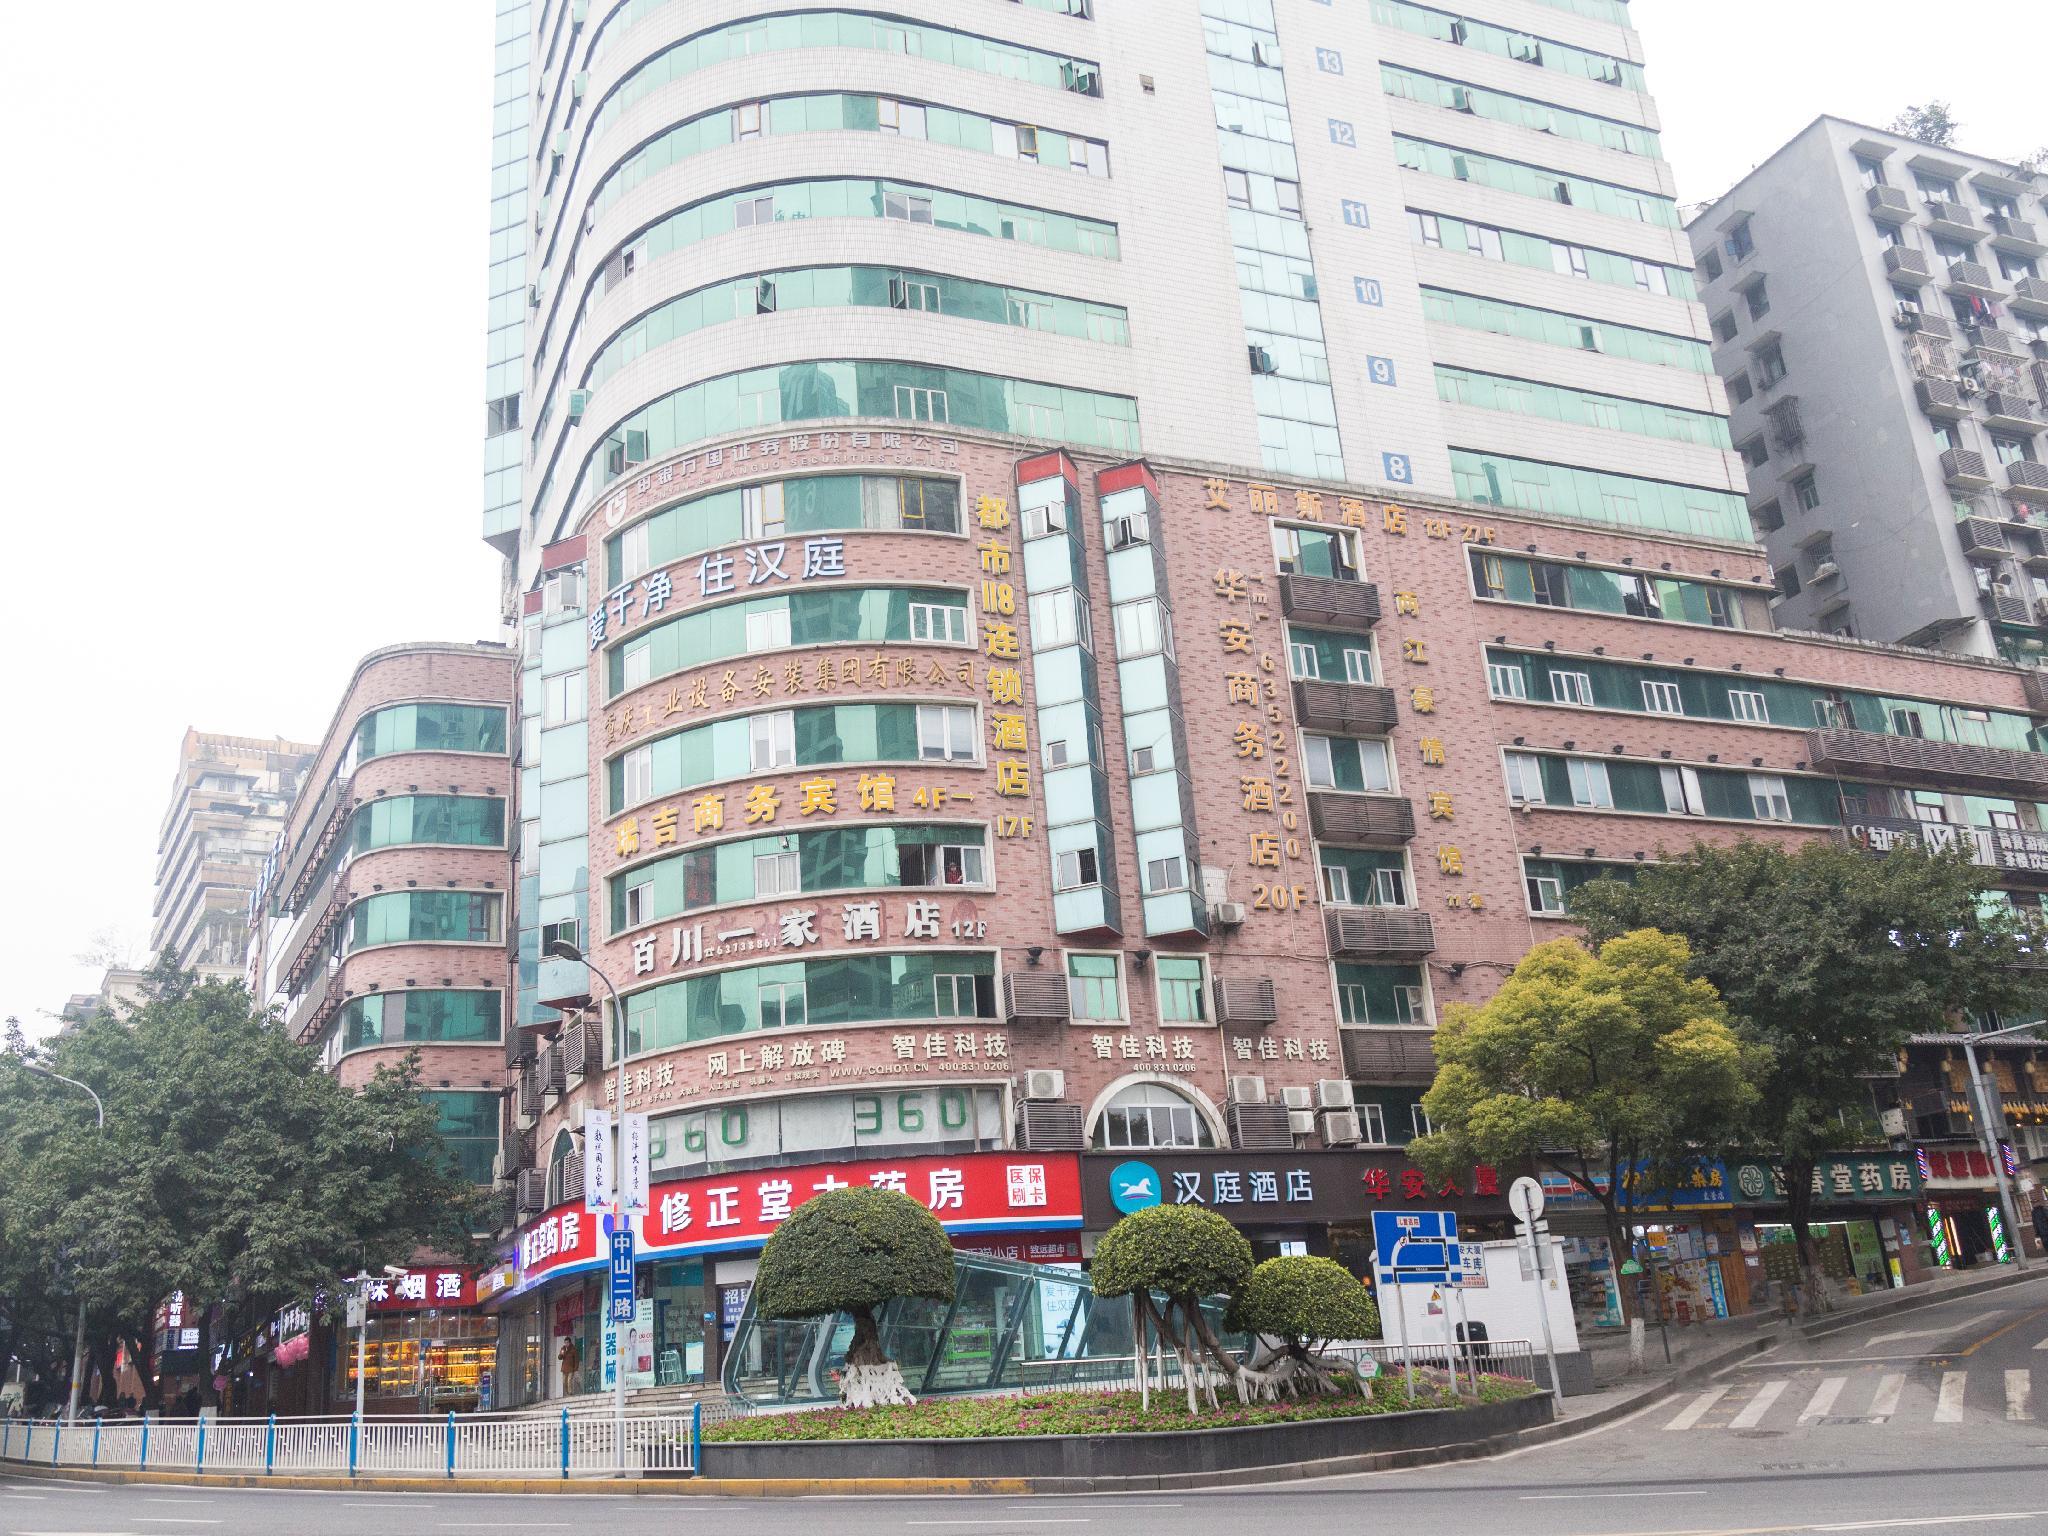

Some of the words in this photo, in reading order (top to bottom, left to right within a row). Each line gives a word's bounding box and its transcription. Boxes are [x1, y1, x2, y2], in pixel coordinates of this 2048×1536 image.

[1318, 49, 1340, 74] 13
[1332, 120, 1354, 146] 12
[1346, 202, 1367, 227] 11
[1357, 279, 1381, 306] 10
[1373, 359, 1390, 384] 9
[636, 431, 960, 495] 申银万国证券股份有限公司
[715, 461, 780, 480] WANGUO
[790, 453, 885, 467] SECURITIES
[1388, 456, 1406, 482] 8
[1203, 477, 1408, 536] 艾丽斯酒店
[588, 570, 672, 650] 爱干净
[696, 537, 846, 597] 住汉庭
[603, 652, 976, 748] 重庆工业设备安装集团有限公司
[1213, 568, 1281, 868] 华安商务酒店
[1394, 591, 1464, 876] 两江豪情宾馆
[615, 773, 896, 858] 瑞吉商务宾馆
[912, 786, 947, 811] 4F
[1251, 883, 1307, 911] 20F
[631, 898, 941, 976] 百川一家酒店
[951, 919, 988, 939] 12F
[1091, 1033, 1195, 1060] 智佳科技
[1232, 1036, 1330, 1061] 智佳科技
[604, 1061, 676, 1102] 智佳科技
[708, 1039, 847, 1079] 网上解放碑
[891, 1032, 1008, 1061] 智佳科技
[708, 1080, 741, 1092] 人工智能
[748, 1076, 776, 1087] 机器人
[1009, 1168, 1042, 1185] 医保
[1172, 1169, 1314, 1205] 汉庭酒店
[1012, 1188, 1044, 1205] 刷卡
[523, 1211, 580, 1270] 修正堂药房
[342, 1273, 462, 1302] 味烟酒
[613, 1234, 632, 1319] 中山二路
